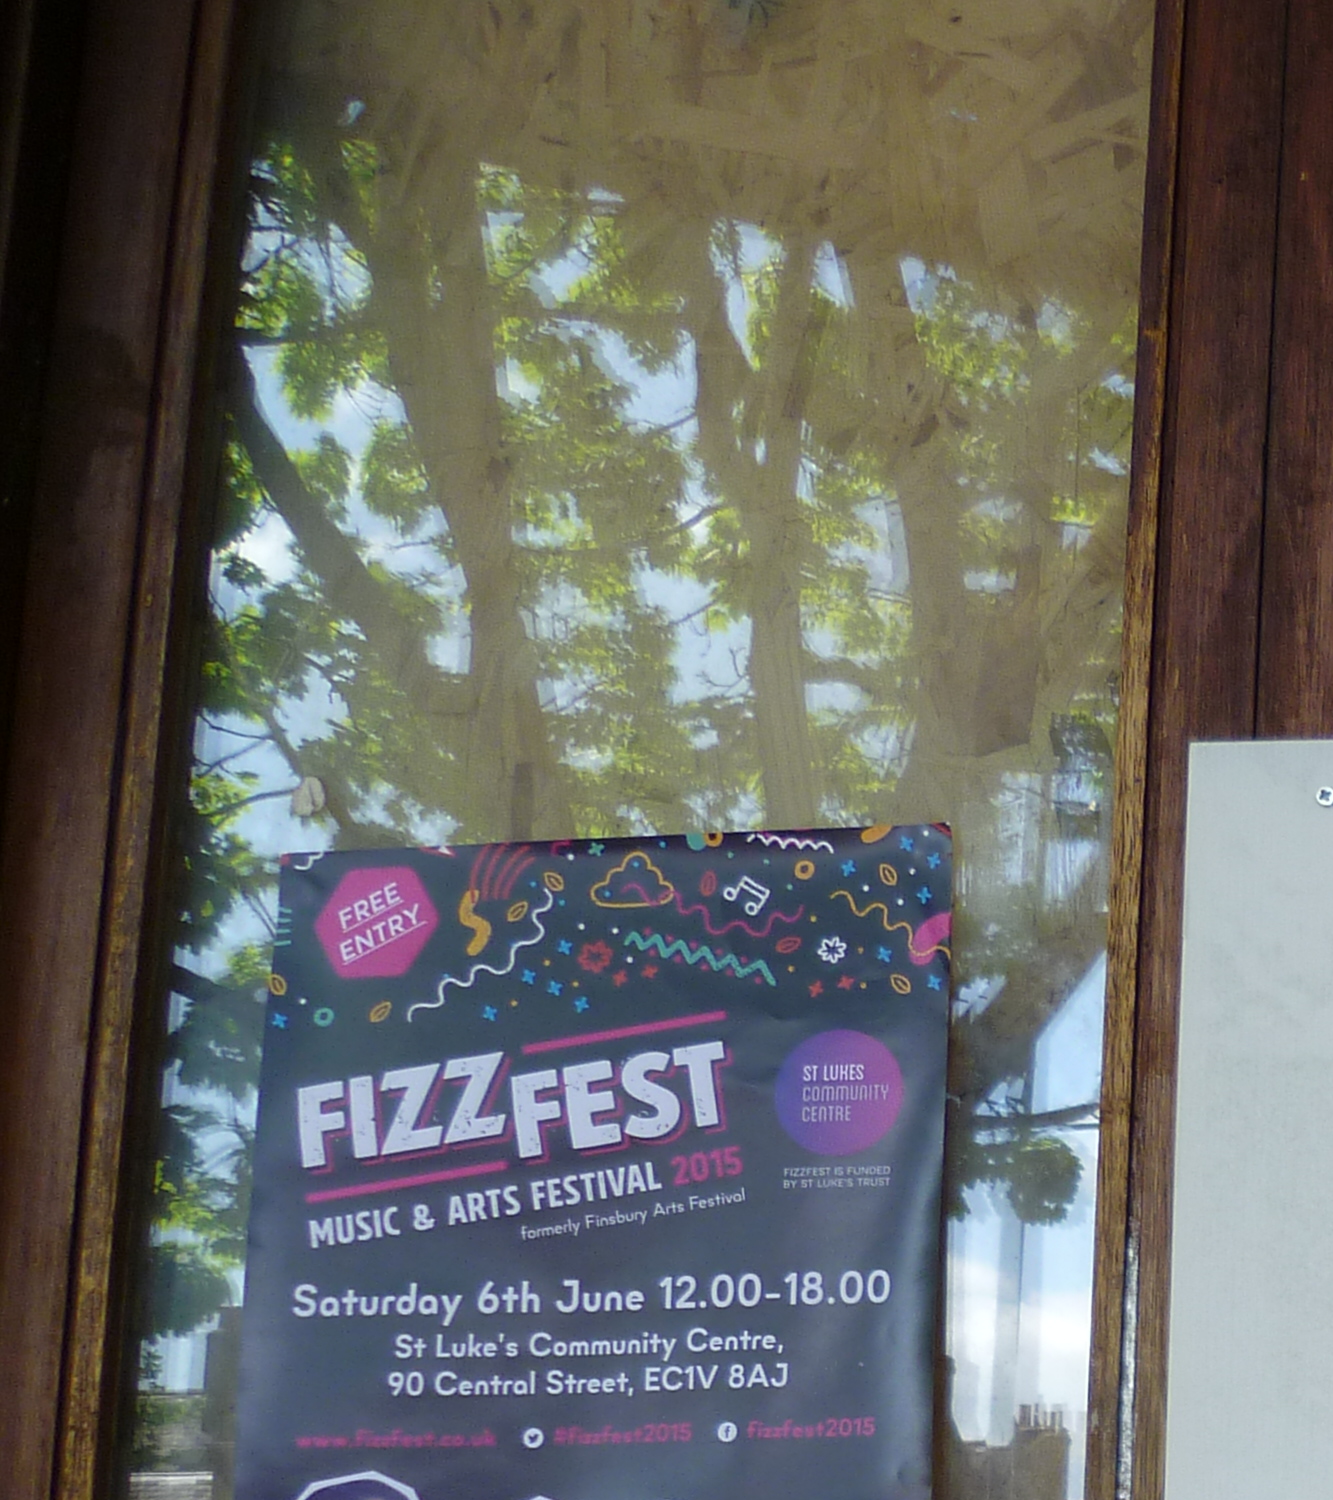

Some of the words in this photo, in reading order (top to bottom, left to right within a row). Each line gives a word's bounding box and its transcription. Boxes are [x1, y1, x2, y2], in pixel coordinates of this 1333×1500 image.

[336, 881, 403, 932] FREE
[338, 902, 424, 964] ENTRY
[802, 1064, 819, 1082] ST
[823, 1063, 865, 1082] LUKES
[802, 1084, 890, 1102] COMMUNITY
[801, 1105, 852, 1122] CENTRE
[308, 1205, 401, 1248] MUSIC
[413, 1203, 436, 1231] &
[447, 1185, 522, 1227] ARTS
[531, 1161, 662, 1212] FESTIVAL
[670, 1147, 743, 1186] 2015
[520, 1217, 581, 1241] formerly
[585, 1205, 648, 1231] Finsbury
[652, 1198, 685, 1218] Arts
[688, 1188, 747, 1212] Festival
[292, 1282, 462, 1326] Saturday
[476, 1282, 542, 1316] 6th
[555, 1280, 645, 1314] June
[659, 1270, 892, 1310] 12.00-18.00
[395, 1333, 427, 1360] St
[435, 1331, 519, 1359] Luke's
[529, 1329, 677, 1363] Community
[686, 1328, 785, 1356] Centre,
[388, 1372, 424, 1398] 90
[435, 1370, 538, 1397] Central
[546, 1369, 635, 1397] Street,
[644, 1366, 719, 1392] EC1V
[729, 1363, 790, 1390] 8AJ
[746, 1416, 876, 1440] fizzfest2015
